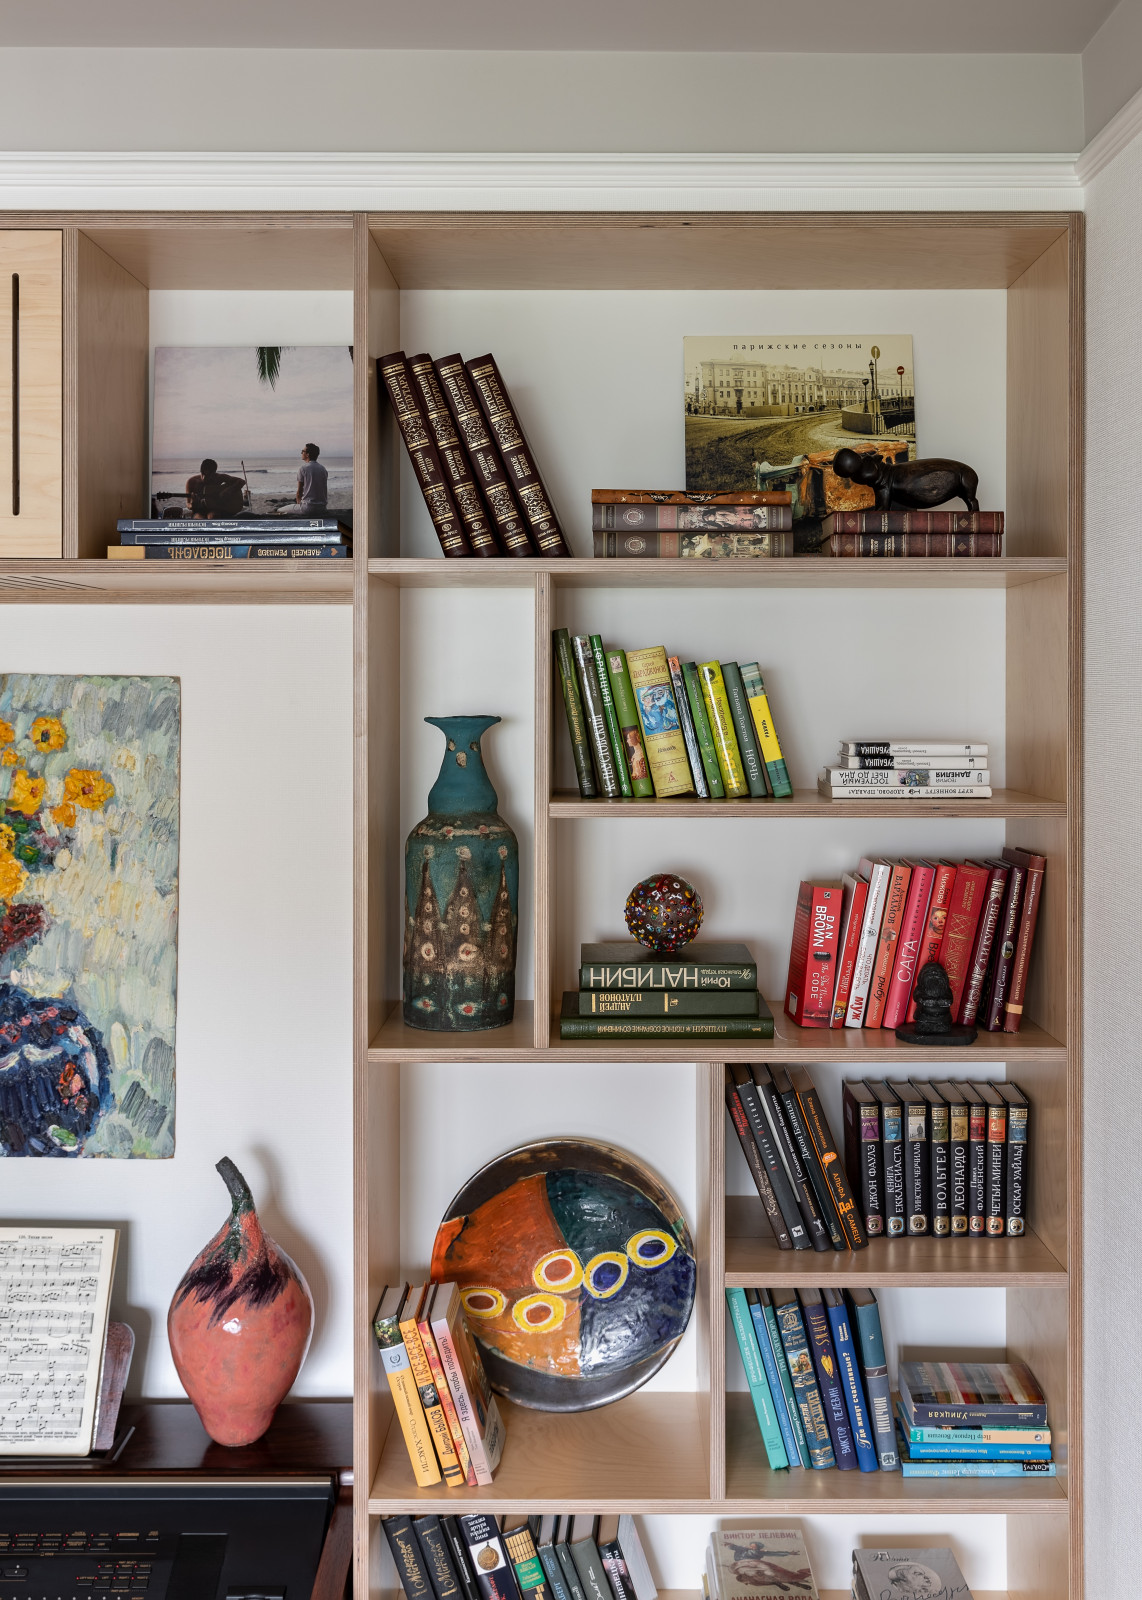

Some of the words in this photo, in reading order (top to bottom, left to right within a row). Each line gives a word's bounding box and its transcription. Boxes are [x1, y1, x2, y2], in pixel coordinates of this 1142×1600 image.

[388, 377, 407, 412] ДЕТСКИЙ
[398, 374, 415, 410] ПЛУТАРХ
[418, 375, 436, 410] ДЕТСКИЙ
[427, 374, 444, 408] ПЛУТАРХ
[445, 377, 466, 412] ДЕТСКИЙ
[456, 374, 474, 410] ПЛУТАРХ
[477, 379, 498, 414] ДЕТСКИЙ
[487, 375, 506, 411] ПЛУТАРХ
[414, 451, 430, 481] ДРЕВНИЙ
[424, 457, 435, 472] МИР
[445, 450, 460, 480] ИСТОРИЯ
[453, 450, 466, 475] РОССИИ
[476, 452, 491, 480] СРЕДНИЕ
[486, 455, 497, 472] ВЕКА
[510, 456, 524, 478] НОВОЕ
[518, 454, 531, 476] ВРЕМЯ
[168, 547, 232, 559] ПОСОЛОНЬ
[257, 548, 288, 557] РЕМИЗОВ
[291, 548, 321, 557] АЛЕКСЕЙ
[566, 680, 578, 716] долголетия
[732, 687, 742, 714] Татьяна
[739, 716, 748, 742] Толстая
[572, 716, 582, 744] Правила
[589, 714, 613, 778] ПАУСТОВСКИЙ
[861, 746, 890, 755] РУБАШКА
[745, 749, 758, 780] НОЧЬ
[865, 758, 894, 767] РУБАШКА
[604, 779, 615, 791] К.
[888, 875, 902, 924] ВАРЛАМОВ
[936, 873, 949, 903] Чижова
[813, 906, 826, 946] BROWN
[825, 915, 834, 939] DAN
[983, 903, 998, 945] КУПРИН
[897, 938, 917, 982] САГА
[590, 967, 698, 987] НАГИБИН
[810, 972, 819, 998] CODE
[820, 975, 829, 986] Da
[874, 976, 886, 1001] рыбу
[600, 993, 642, 1002] ПЛАТОНОВ
[600, 1002, 631, 1013] АНДРЕЙ
[850, 996, 864, 1020] муж
[731, 1106, 746, 1136] Анатолий
[733, 1092, 748, 1127] Приставкин
[786, 1100, 801, 1135] Бэнвилл
[807, 1097, 816, 1114] Елена
[813, 1115, 827, 1148] Новоселова
[798, 1136, 810, 1159] Джон
[867, 1144, 876, 1176] ФАУЛЗ
[1012, 1145, 1023, 1179] УАЙЛЬД
[833, 1173, 845, 1198] АЛЬФА
[893, 1145, 903, 1212] ЕККЛЕСИАСТА
[936, 1147, 946, 1208] ВОЛЬТЕР
[954, 1147, 965, 1209] ЛЕОНАРДО
[975, 1145, 984, 1210] ФЛОРЕНСКИЙ
[991, 1144, 1001, 1215] ЧЕТЬИ-МИНЕИ
[868, 1180, 878, 1209] ДЖОН
[1013, 1182, 1021, 1214] ОСКАР
[847, 1214, 861, 1243] САМЕЦ?
[403, 1328, 428, 1376] ВСЕ-ВСЕ-ВСЕ
[768, 1318, 783, 1357] РАЗГОВОРА
[439, 1336, 454, 1370] победить!
[778, 1358, 786, 1373] ТРИ
[450, 1371, 461, 1392] чтобы
[842, 1352, 858, 1402] счастливые?
[458, 1392, 468, 1414] здесь,
[799, 1402, 814, 1433] ВАСИЛИЙ
[806, 1388, 826, 1440] ШУКШИН
[829, 1387, 843, 1421] ПЕЛЕВИН
[854, 1405, 863, 1426] живут
[873, 1396, 890, 1433] ПИНЧОН
[928, 1411, 967, 1420] Улицкая
[430, 1409, 446, 1432] БЫКОВ
[440, 1432, 453, 1455] Дмитрий
[836, 1425, 851, 1454] ВИКТОР
[856, 1429, 870, 1448] Где
[415, 1439, 429, 1472] ХАКСЛИ
[468, 1517, 485, 1526] загадка
[470, 1522, 486, 1531] артура
[470, 1527, 490, 1537] гордона
